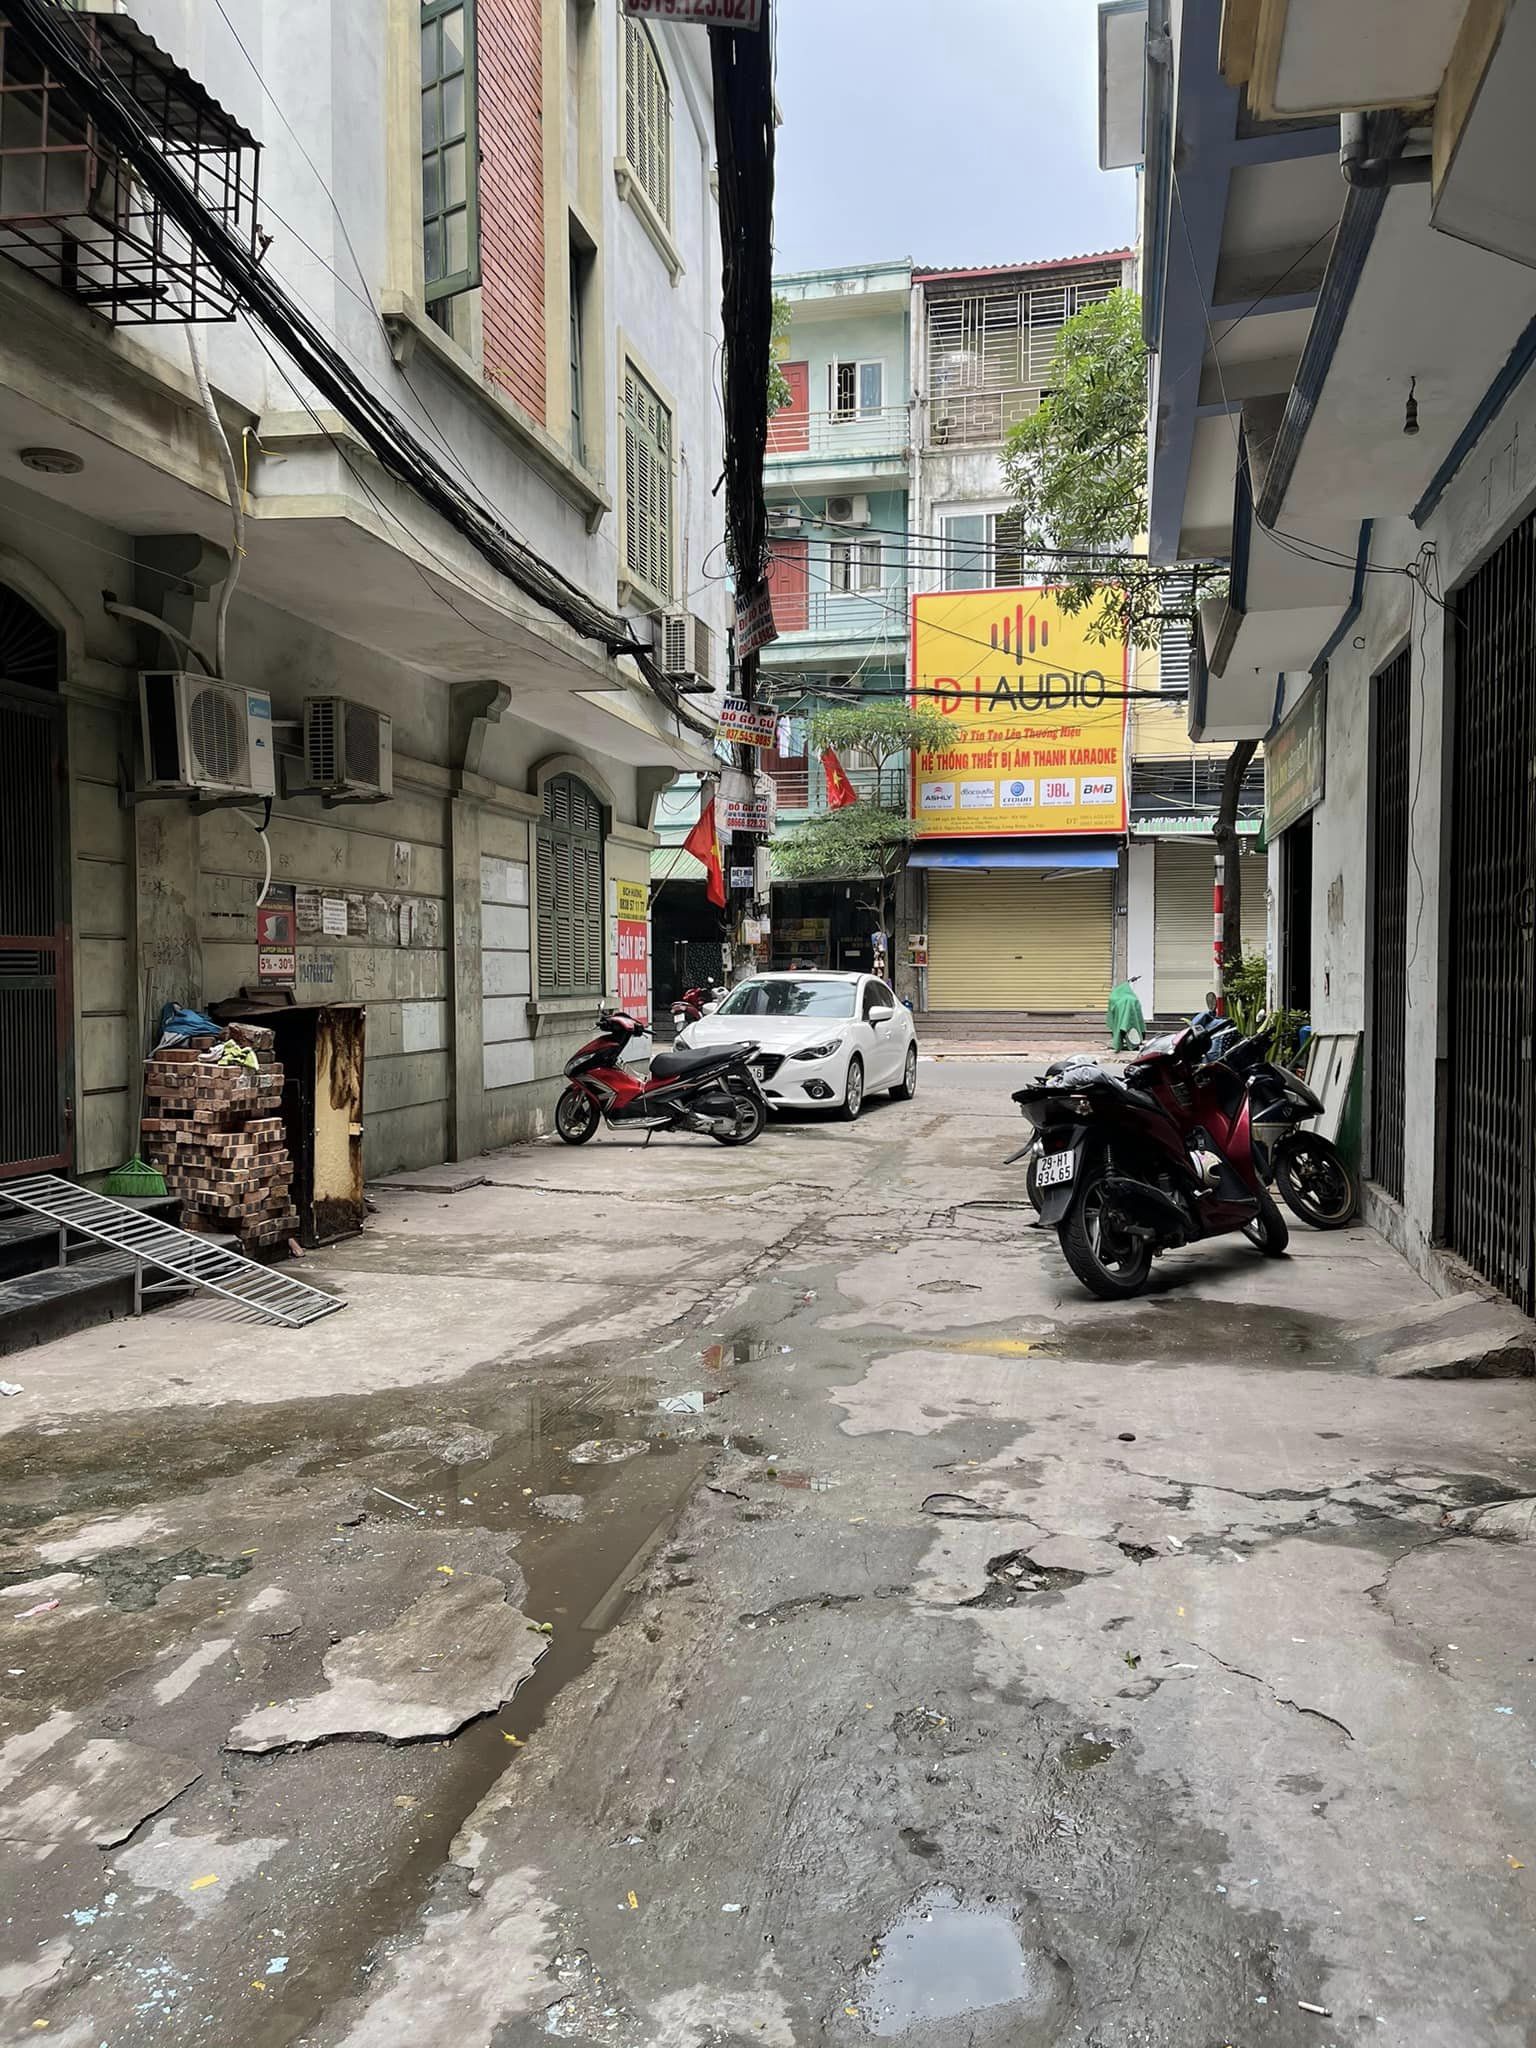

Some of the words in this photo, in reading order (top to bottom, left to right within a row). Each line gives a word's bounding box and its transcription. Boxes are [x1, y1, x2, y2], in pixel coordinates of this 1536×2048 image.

[988, 670, 1105, 713] AUDIO
[723, 699, 751, 713] MUA
[921, 752, 934, 774] HỆ
[936, 748, 969, 771] THỐNG
[971, 746, 999, 769] THIẾT
[1001, 752, 1012, 771] BỊ
[1014, 748, 1031, 768] ÂM
[1033, 750, 1066, 768] THANH
[1070, 747, 1117, 766] KARAOKE
[1047, 783, 1070, 798] JBL
[1083, 784, 1113, 795] BMB
[261, 958, 273, 970] 5%
[279, 958, 293, 970] 30%
[1042, 1153, 1067, 1171] 29-H1
[1038, 1166, 1071, 1186] 934.65
